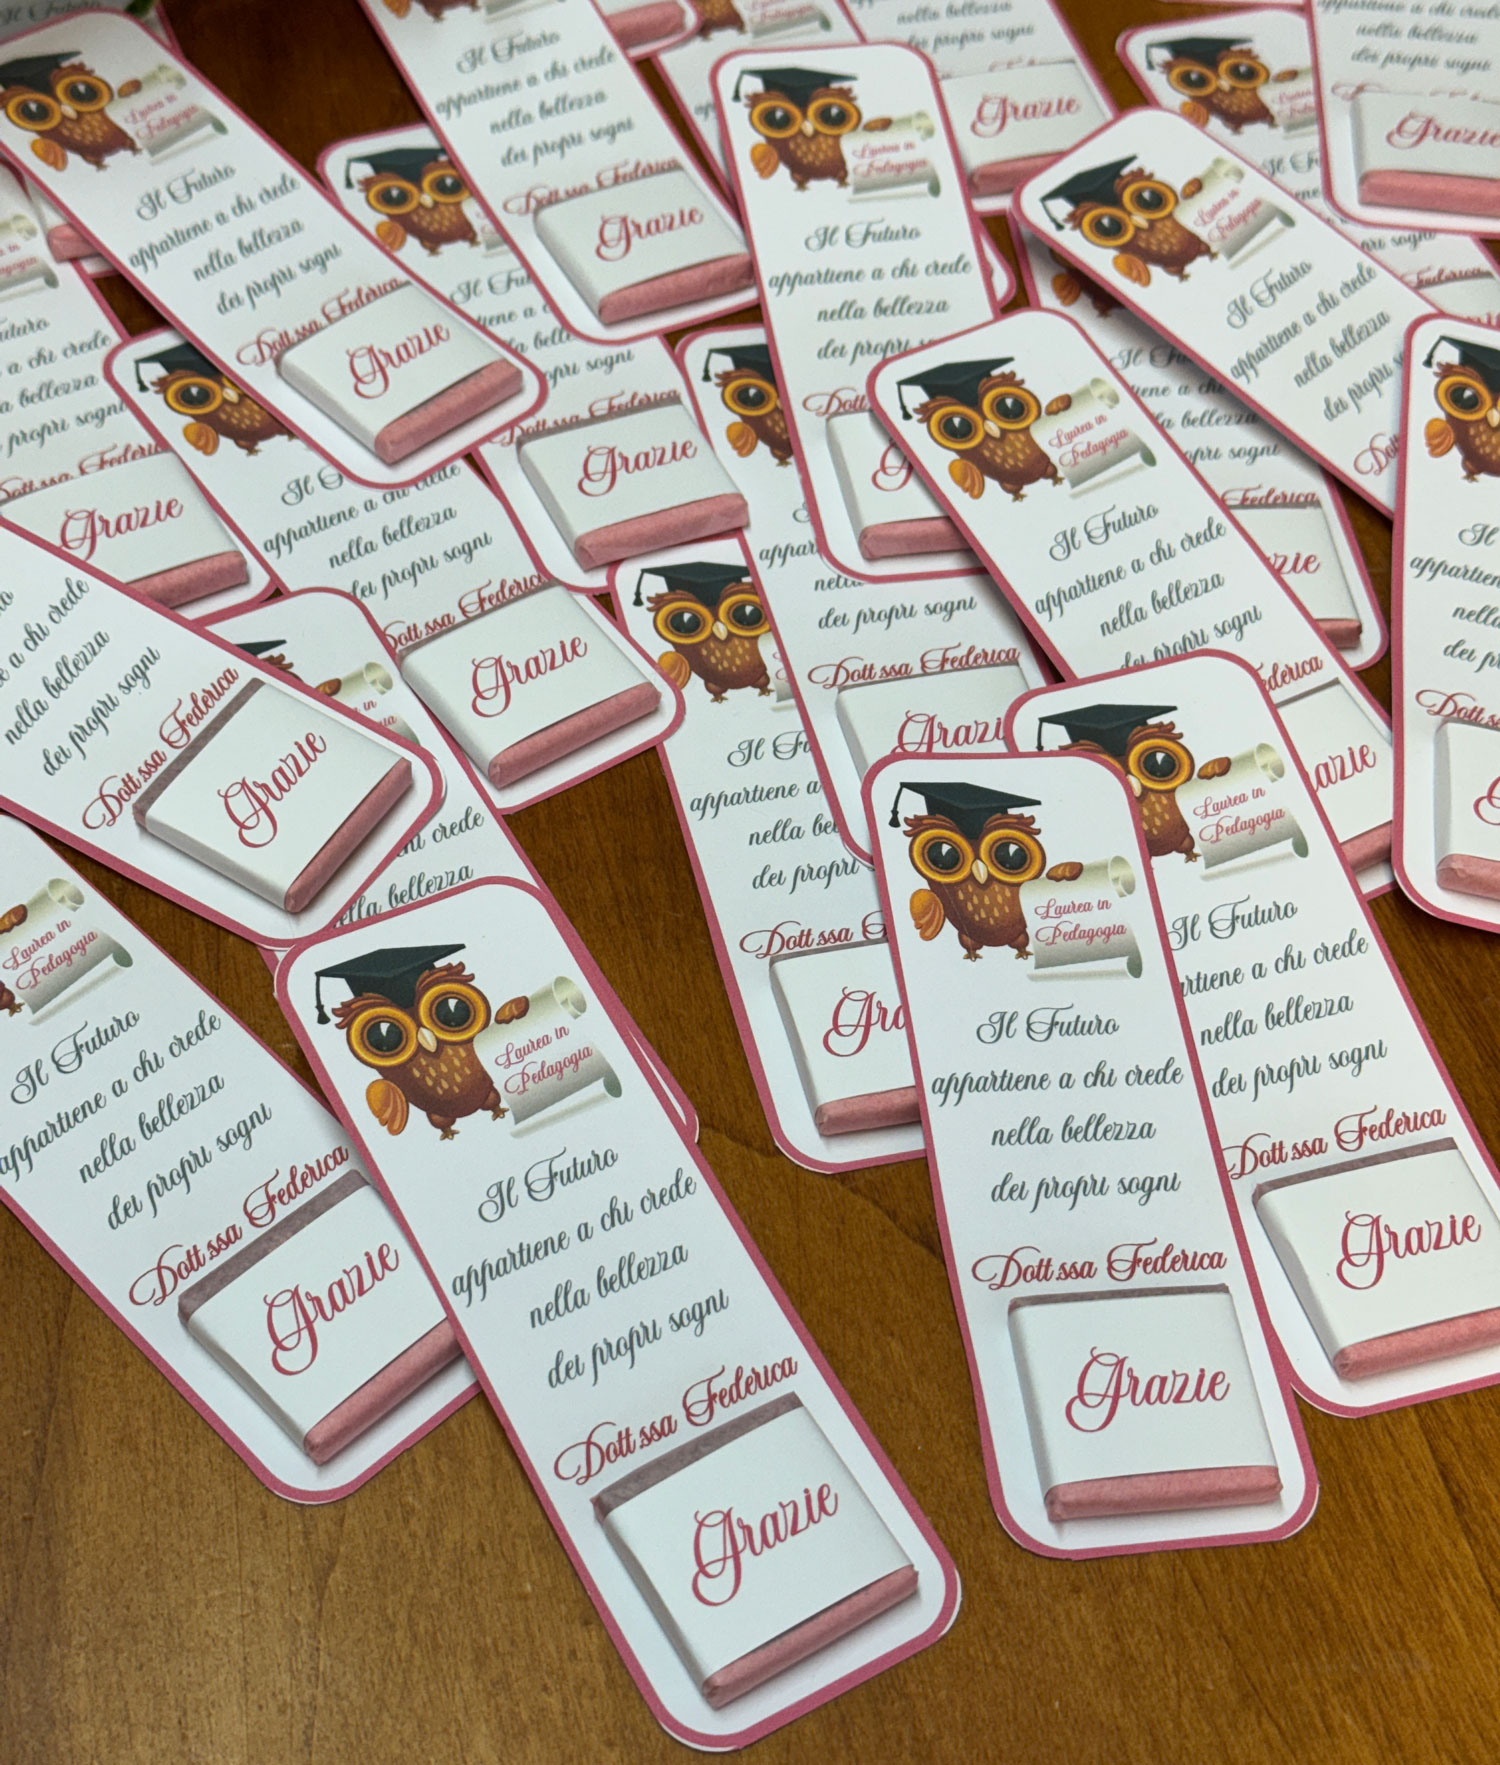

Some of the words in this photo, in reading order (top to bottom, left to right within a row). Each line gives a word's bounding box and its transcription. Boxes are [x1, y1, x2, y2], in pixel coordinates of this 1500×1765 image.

[136, 189, 167, 220] Il
[166, 166, 235, 204] Futuro
[193, 247, 237, 281] nella
[237, 219, 304, 258] bellezza
[804, 226, 840, 251] Il
[844, 218, 922, 248] Futuro
[217, 290, 245, 315] dei
[245, 265, 296, 311] propri
[298, 242, 342, 274] sogni
[321, 277, 405, 324] Federica
[768, 267, 866, 297] appartiene
[871, 268, 886, 280] a
[891, 257, 920, 279] chi
[925, 252, 975, 276] crede
[1226, 295, 1254, 329] Il
[1249, 261, 1312, 308] Futuro
[816, 298, 868, 322] nella
[873, 294, 952, 318] bellezza
[1229, 321, 1303, 386] appartiene
[1302, 312, 1317, 327] a
[1316, 290, 1341, 316] chi
[1340, 261, 1378, 298] crede
[62, 330, 111, 358] crede
[346, 324, 449, 399] Grazie
[585, 349, 636, 375] sogni
[1293, 351, 1334, 389] nella
[1329, 310, 1391, 359] bellezza
[18, 375, 98, 408] bellezza
[1324, 396, 1350, 422] dei
[1347, 362, 1395, 415] propri
[1048, 421, 1095, 450] Laurea
[1094, 414, 1108, 426] in
[1058, 429, 1129, 468] Pedagogia
[1228, 444, 1281, 465] sogni
[576, 439, 699, 497] Grazie
[59, 498, 183, 562] Grazie
[328, 536, 378, 570] nella
[381, 507, 457, 547] bellezza
[1048, 526, 1081, 562] Il
[1083, 504, 1159, 546] Futuro
[1459, 523, 1500, 547] Il
[381, 555, 439, 601] propri
[442, 532, 493, 564] sogni
[1033, 565, 1127, 623] appartiene
[1130, 559, 1145, 575] a
[1148, 539, 1177, 567] chi
[1180, 517, 1226, 553] crede
[7, 651, 25, 669] a
[22, 622, 50, 652] chi
[48, 577, 90, 625] crede
[817, 608, 849, 630] dei
[851, 603, 918, 635] propri
[923, 597, 978, 623] sogni
[1100, 600, 1149, 637] nella
[1150, 573, 1225, 615] bellezza
[1213, 604, 1263, 641] sogni
[470, 635, 588, 718] Grazie
[920, 642, 1022, 675] Federica
[1443, 638, 1475, 663] dei
[5, 697, 49, 745] nella
[41, 631, 111, 700] bellezza
[42, 745, 73, 777] dei
[68, 693, 120, 761] propri
[117, 647, 162, 696] sogni
[157, 666, 240, 750] Federica
[217, 731, 328, 849] Grazie
[689, 783, 800, 822] appartiene
[1192, 793, 1249, 821] Laurea
[1250, 787, 1266, 800] in
[748, 817, 806, 847] nella
[1199, 808, 1286, 845] Pedagogia
[751, 864, 785, 891] dei
[787, 858, 861, 896] propri
[1034, 898, 1094, 920] Laurea
[1096, 899, 1112, 911] in
[1034, 920, 1128, 946] Pedagogia
[1167, 912, 1203, 951] Il
[1208, 894, 1299, 940] Futuro
[2, 930, 56, 971] Laurea
[55, 919, 71, 933] in
[16, 931, 98, 990] Pedagogia
[1251, 962, 1268, 980] a
[1274, 943, 1307, 975] chi
[1313, 927, 1370, 965] crede
[494, 1033, 553, 1070] Laurea
[554, 1025, 570, 1040] in
[975, 1010, 1019, 1045] Il
[1025, 1003, 1120, 1043] Futuro
[1201, 1008, 1259, 1046] nella
[1264, 994, 1355, 1031] bellezza
[10, 1058, 49, 1104] Il
[50, 1012, 139, 1075] Futuro
[503, 1046, 594, 1096] Pedagogia
[930, 1069, 1052, 1108] appartiene
[1058, 1073, 1076, 1090] a
[1083, 1059, 1118, 1089] chi
[1124, 1056, 1184, 1087] crede
[1212, 1066, 1247, 1099] dei
[1251, 1054, 1322, 1103] propri
[1328, 1038, 1389, 1078] sogni
[0, 1092, 107, 1183] appartiene
[110, 1079, 128, 1099] a
[131, 1050, 164, 1084] chi
[167, 1011, 220, 1060] crede
[78, 1132, 136, 1185] nella
[137, 1076, 224, 1142] bellezza
[991, 1115, 1054, 1147] nella
[1061, 1112, 1157, 1144] bellezza
[1332, 1104, 1449, 1153] Federica
[107, 1195, 143, 1231] dei
[145, 1146, 212, 1220] propri
[215, 1103, 272, 1153] sogni
[242, 1142, 351, 1228] Federica
[477, 1176, 519, 1224] Il
[523, 1147, 619, 1203] Futuro
[990, 1172, 1028, 1203] dei
[1029, 1173, 1110, 1214] propri
[1117, 1172, 1182, 1206] sogni
[449, 1231, 570, 1309] appartiene
[576, 1222, 594, 1244] a
[599, 1196, 634, 1233] chi
[639, 1167, 697, 1216] crede
[1106, 1237, 1228, 1282] Federica
[1336, 1210, 1483, 1289] Grazie
[263, 1241, 400, 1376] Grazie
[529, 1280, 590, 1330] nella
[595, 1244, 689, 1300] bellezza
[547, 1350, 585, 1390] dei
[591, 1319, 662, 1388] propri
[668, 1288, 730, 1338] sogni
[682, 1354, 799, 1426] Federica
[1065, 1346, 1231, 1433] Grazie
[691, 1481, 839, 1607] Grazie
